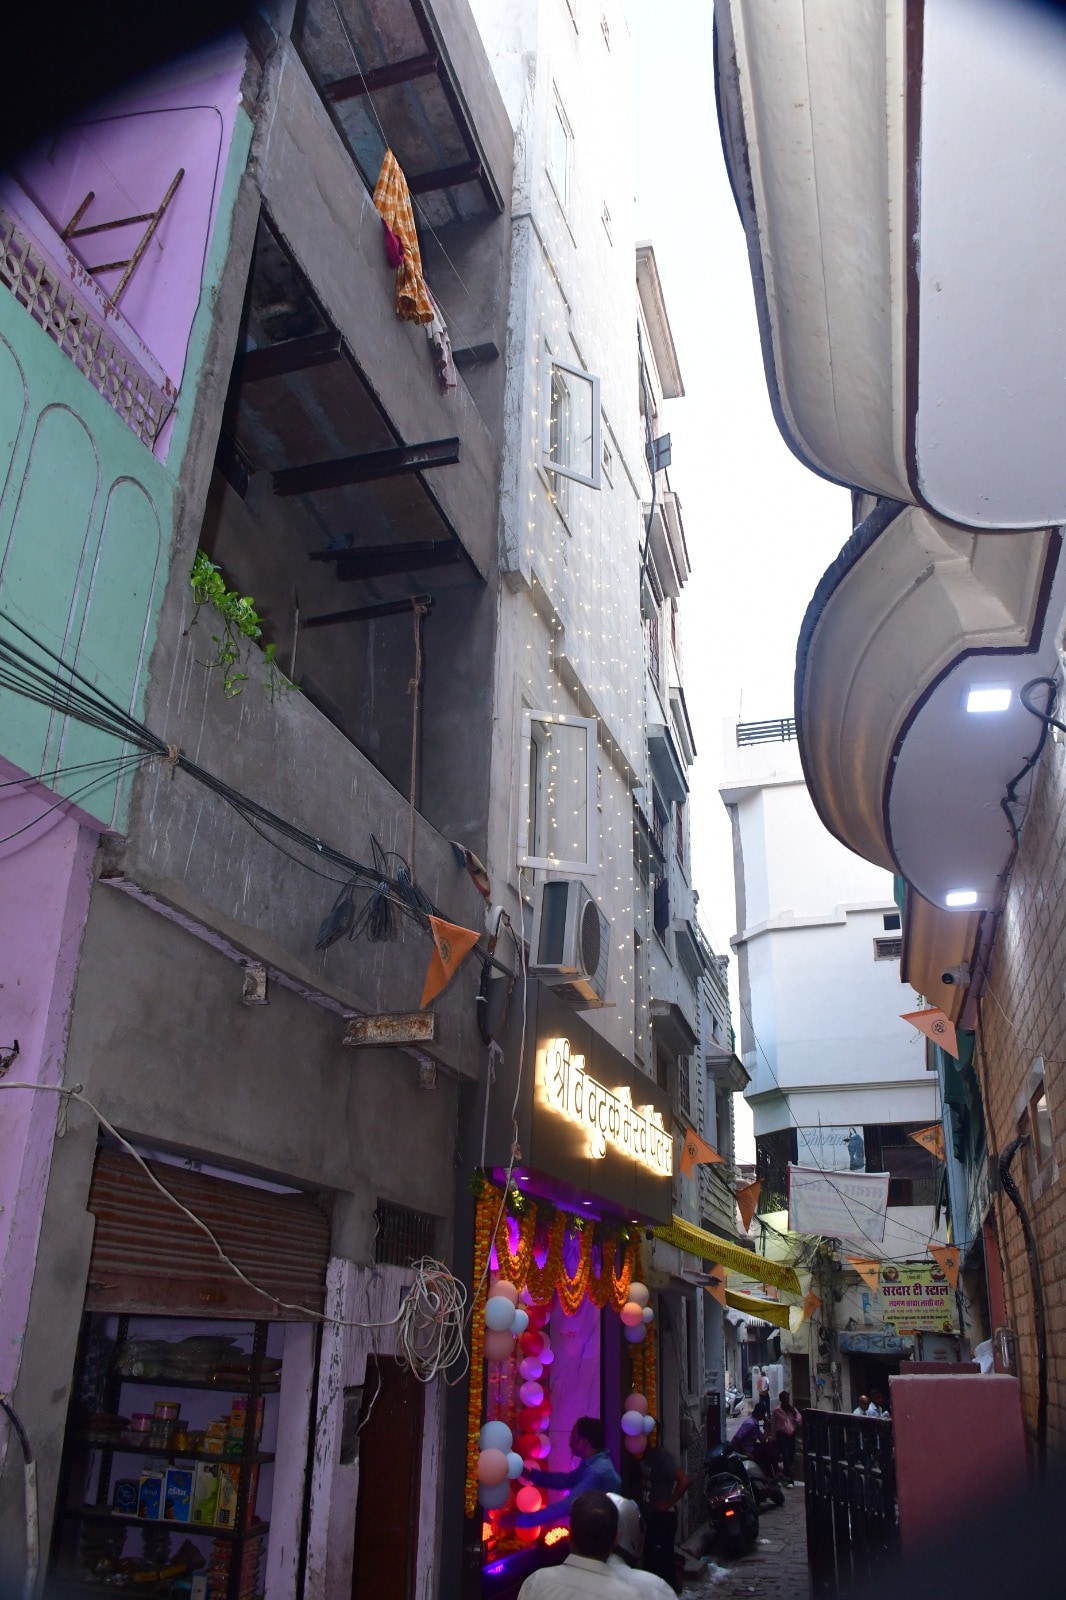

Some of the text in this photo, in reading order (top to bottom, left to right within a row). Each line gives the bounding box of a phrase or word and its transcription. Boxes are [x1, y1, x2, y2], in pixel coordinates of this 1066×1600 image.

[550, 1038, 571, 1111] श्री
[882, 1282, 949, 1296] सरदार टी स्टाल
